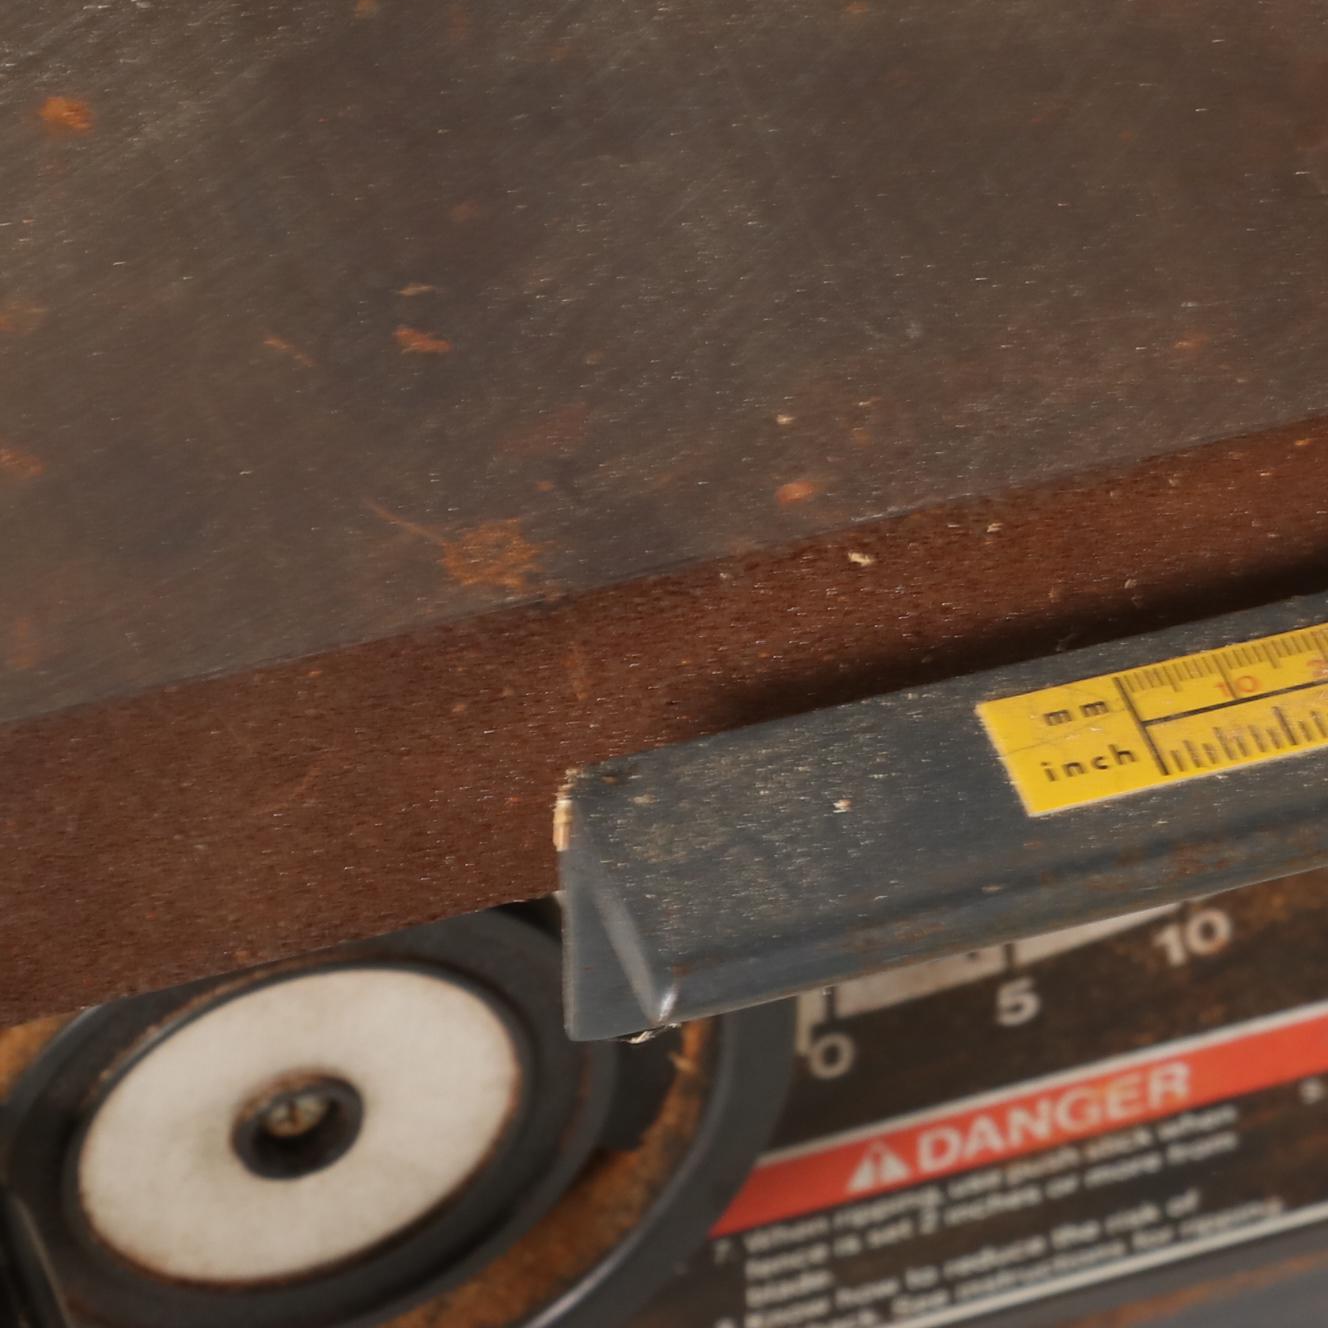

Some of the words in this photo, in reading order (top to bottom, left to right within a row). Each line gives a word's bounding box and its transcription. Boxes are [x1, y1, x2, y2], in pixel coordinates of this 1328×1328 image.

[1040, 743, 1138, 782] inch
[1152, 907, 1232, 965] 10
[995, 977, 1041, 1026] 5
[915, 1060, 1193, 1174] DANGER
